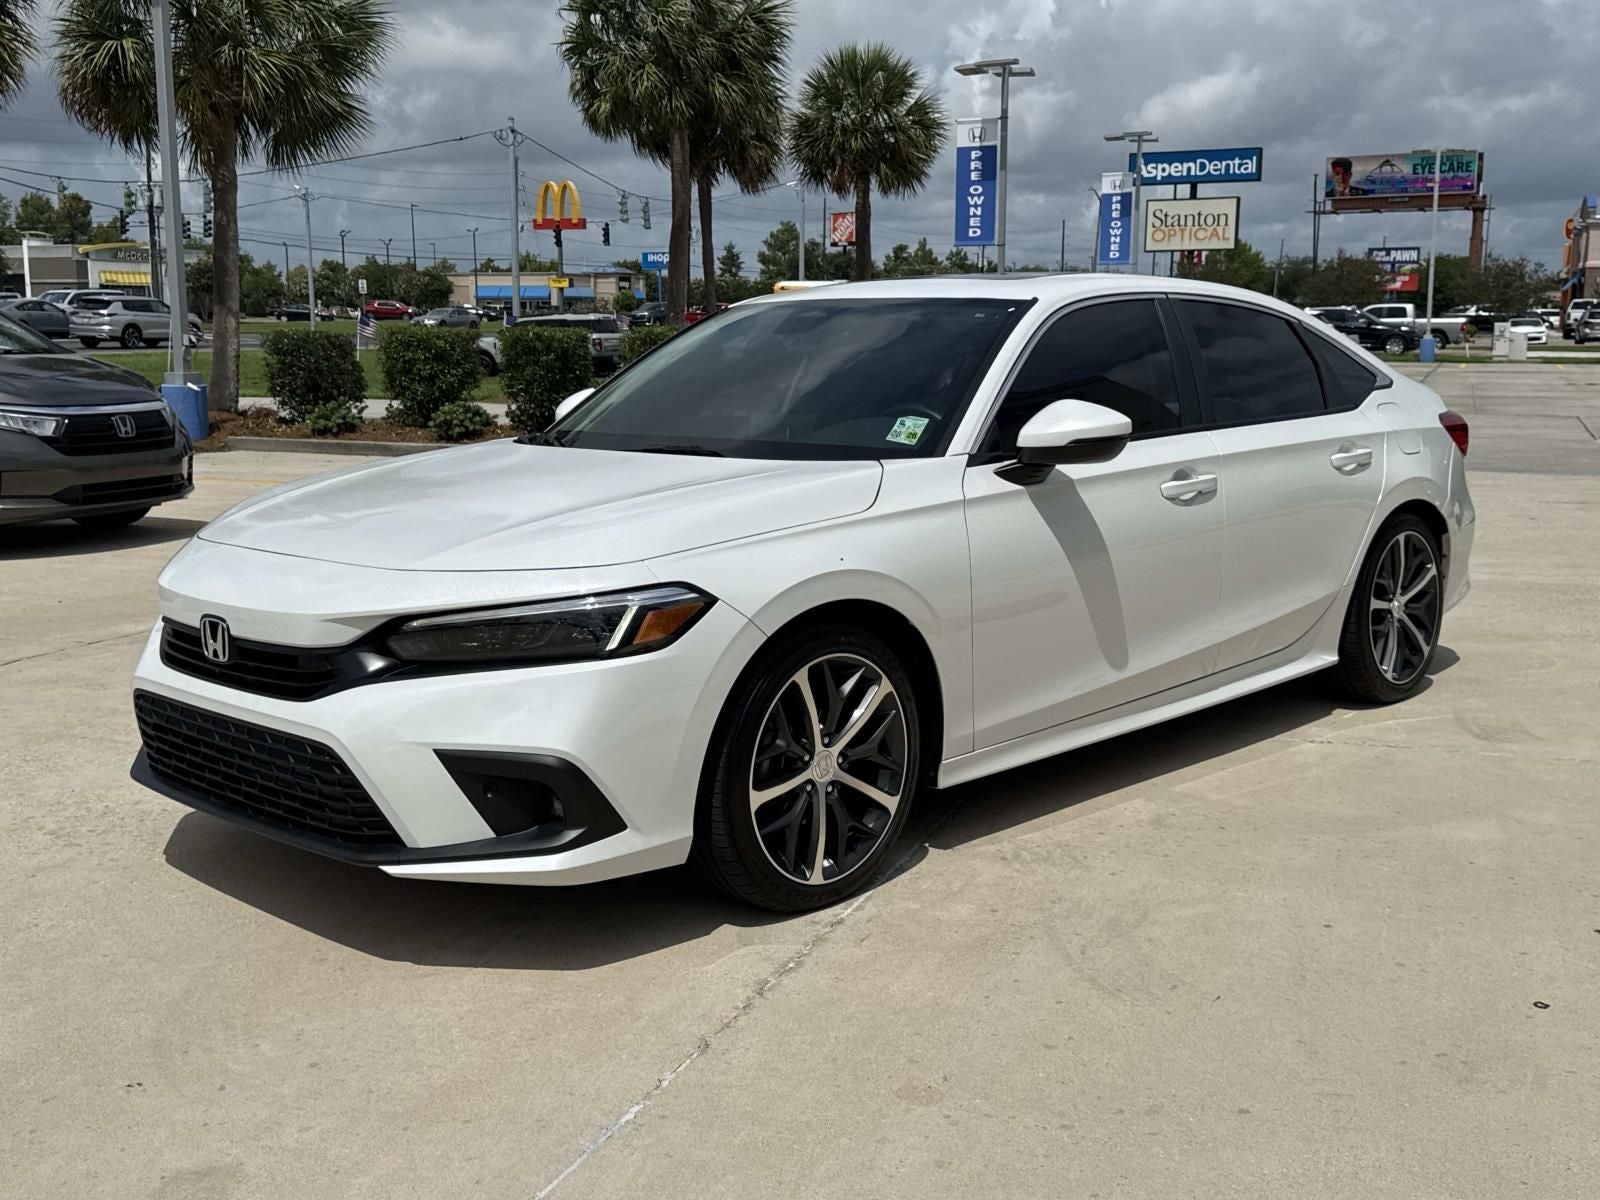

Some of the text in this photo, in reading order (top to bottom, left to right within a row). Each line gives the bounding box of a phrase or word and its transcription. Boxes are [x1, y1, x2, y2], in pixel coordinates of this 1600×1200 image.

[1412, 161, 1473, 175] EYE CARE
[967, 150, 984, 237] PRE OWNED
[1151, 208, 1228, 228] Stanton
[1109, 195, 1122, 259] PRE OWNED
[1151, 227, 1230, 242] OPTICAL
[1390, 249, 1418, 262] PAWN
